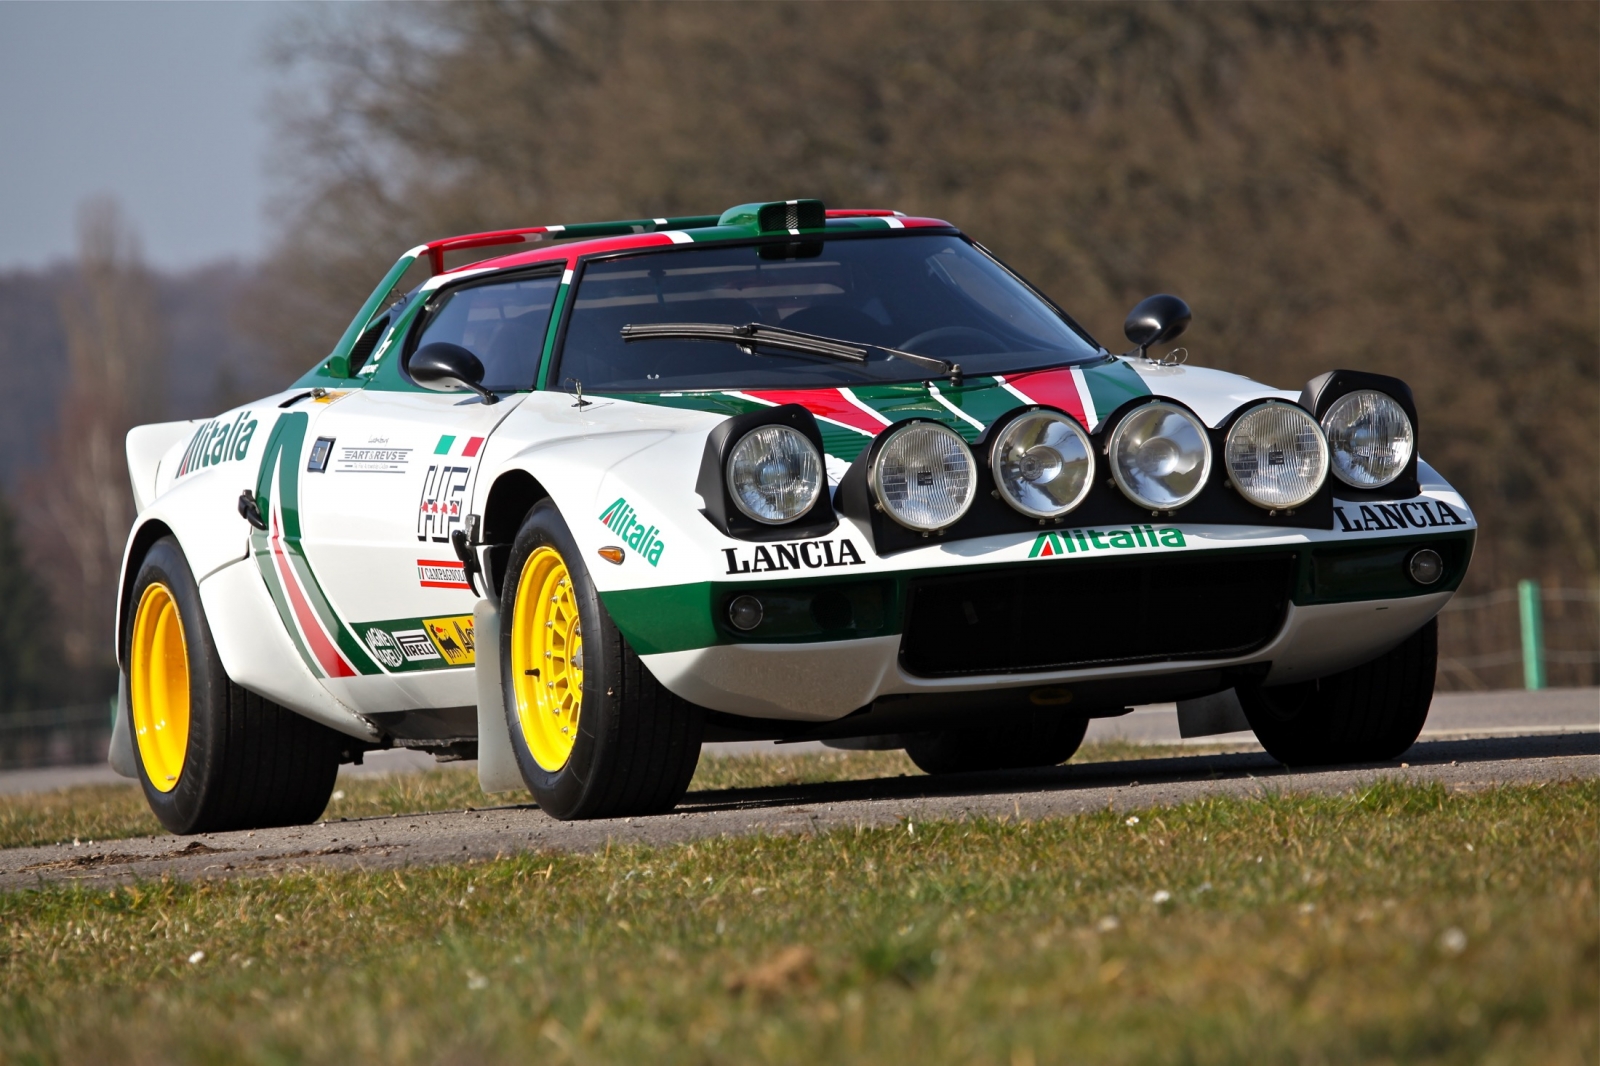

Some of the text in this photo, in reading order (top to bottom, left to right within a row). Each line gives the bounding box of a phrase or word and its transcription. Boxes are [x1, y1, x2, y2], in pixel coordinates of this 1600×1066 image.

[175, 411, 258, 479] Alitalia
[598, 497, 665, 568] Alitalia
[1332, 501, 1466, 532] LANCIA
[721, 538, 866, 575] LANCIA
[1028, 524, 1187, 559] Alitalia
[396, 634, 437, 657] PIRELLI
